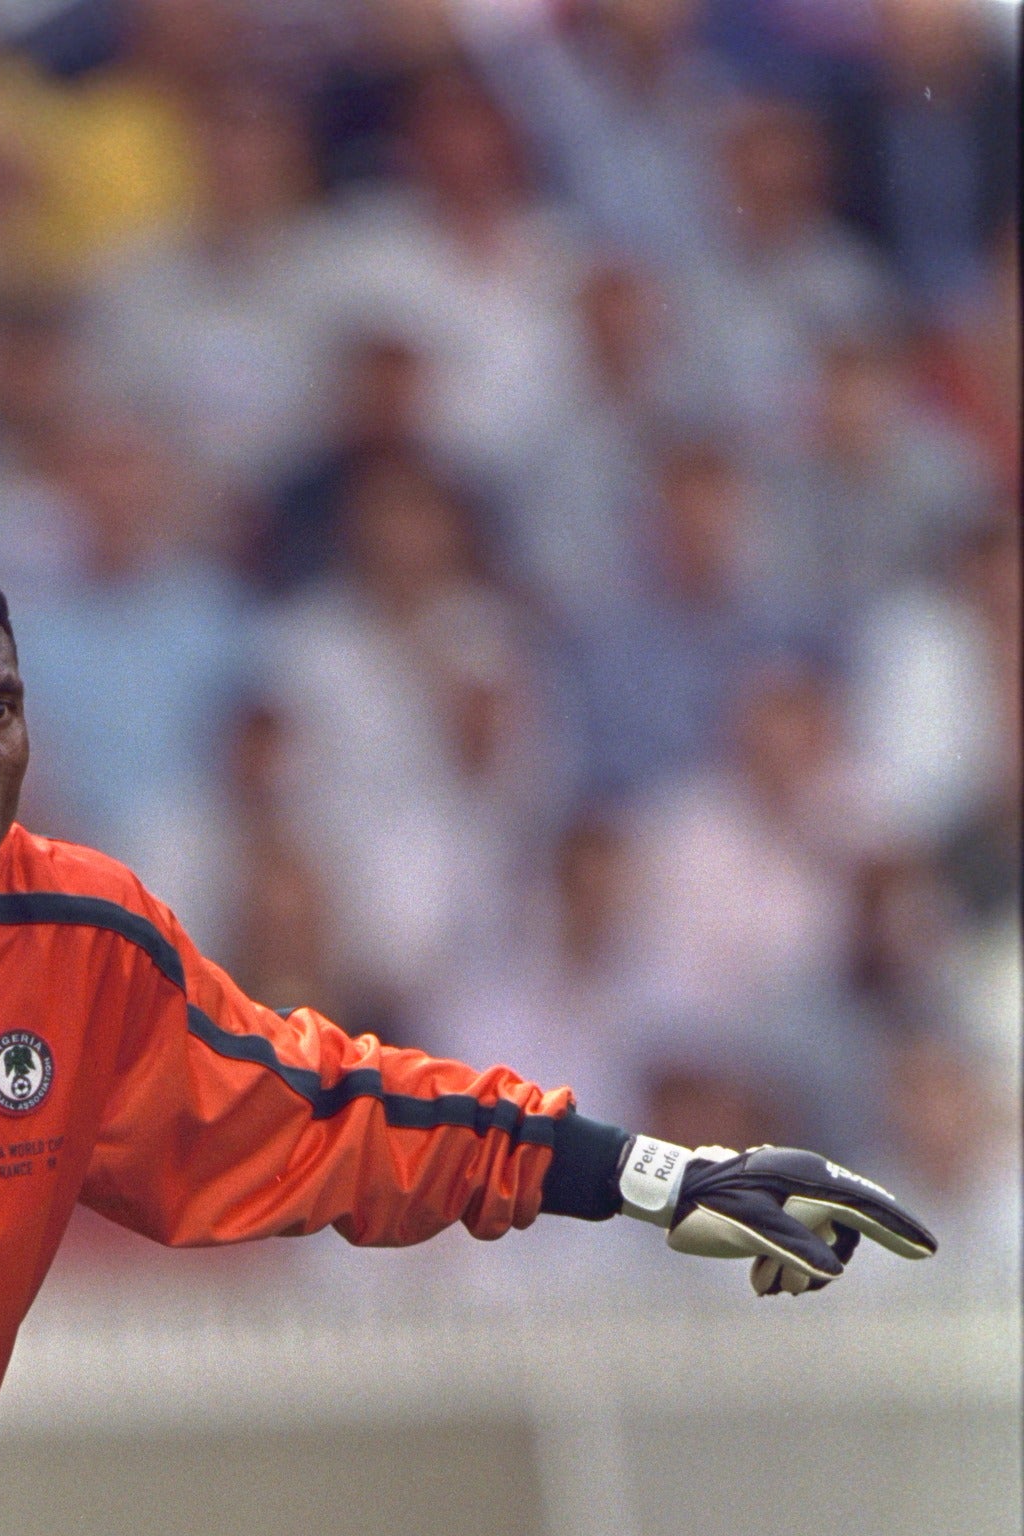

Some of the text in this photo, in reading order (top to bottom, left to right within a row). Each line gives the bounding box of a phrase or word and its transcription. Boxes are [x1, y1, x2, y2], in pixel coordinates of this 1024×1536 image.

[17, 1057, 52, 1110] ASSOCIATION
[8, 1138, 45, 1157] WORLD
[633, 1143, 659, 1175] Pete
[654, 1149, 680, 1182] Rufa
